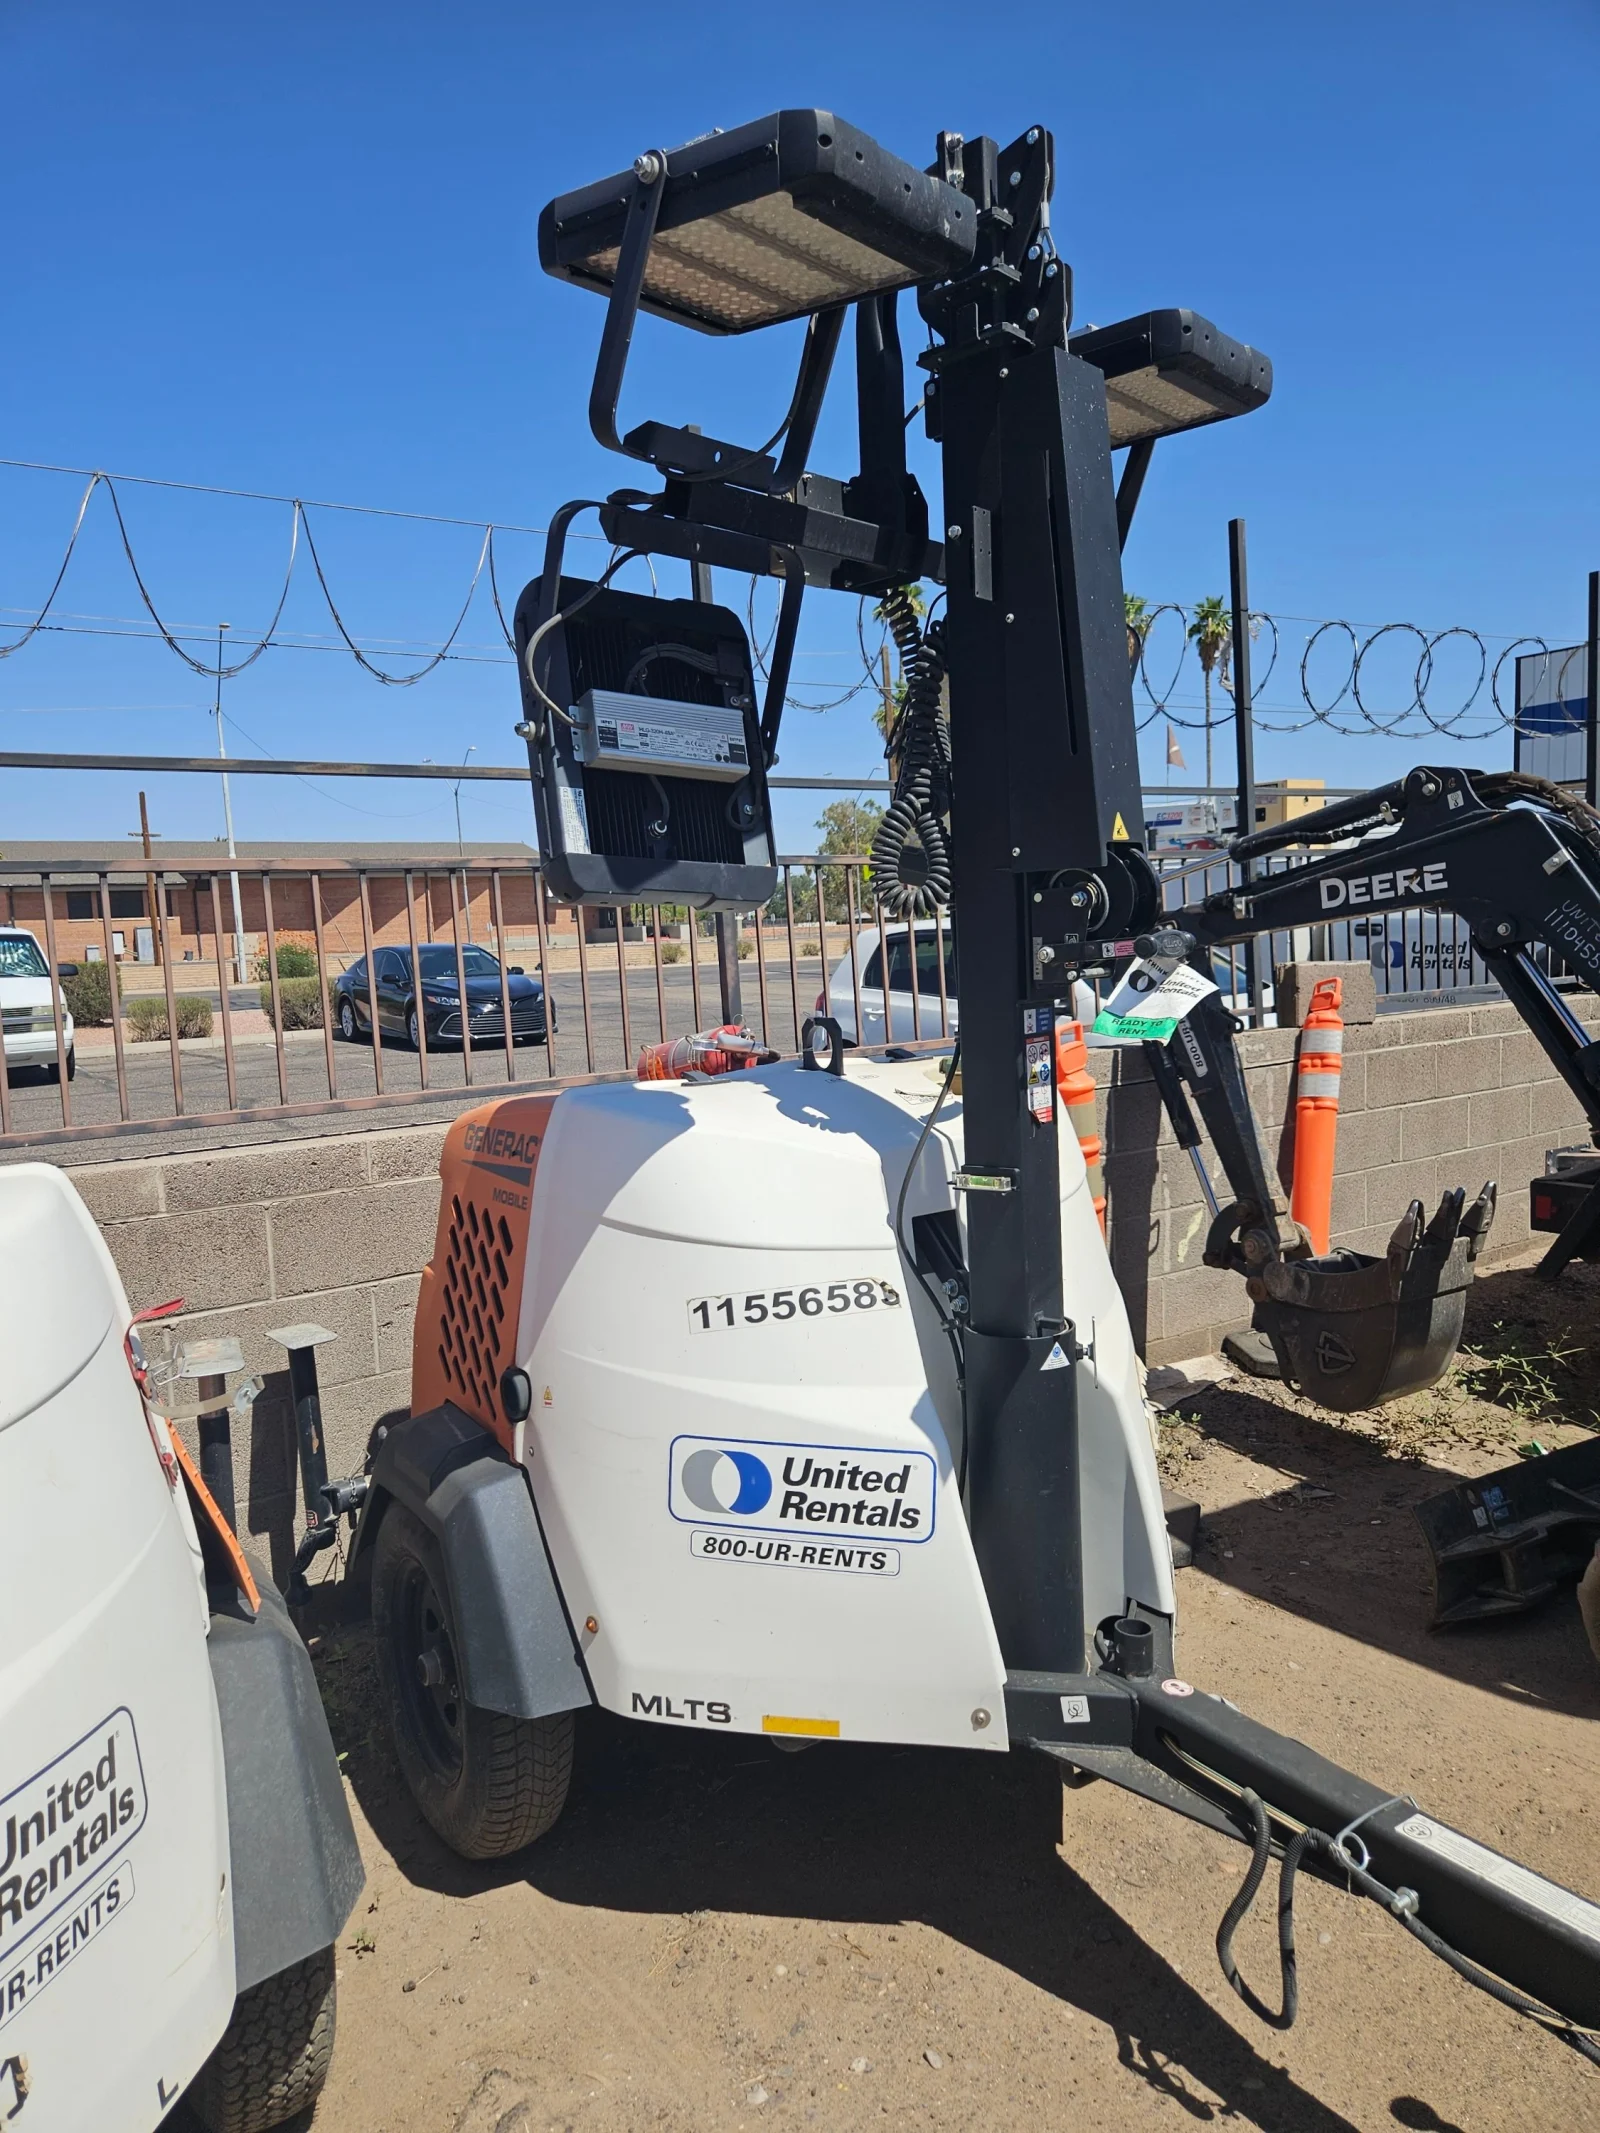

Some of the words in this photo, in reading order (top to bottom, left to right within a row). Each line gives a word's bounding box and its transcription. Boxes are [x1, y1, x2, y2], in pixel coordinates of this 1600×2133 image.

[1320, 862, 1448, 909] DEERE
[1544, 908, 1600, 975] 1110455
[1147, 959, 1168, 976] THINK
[1154, 986, 1200, 999] Rentals
[1111, 1018, 1148, 1027] READY
[1150, 1019, 1163, 1027] TO
[1117, 1027, 1147, 1036] RENT
[464, 1123, 539, 1164] GENERAC
[493, 1187, 528, 1211] MOBILE
[782, 1456, 912, 1494] United
[779, 1490, 921, 1529] Rentals
[702, 1536, 888, 1570] 800-UR-RENTS
[631, 1691, 732, 1724] MLTS
[0, 1786, 135, 1938] Rentals
